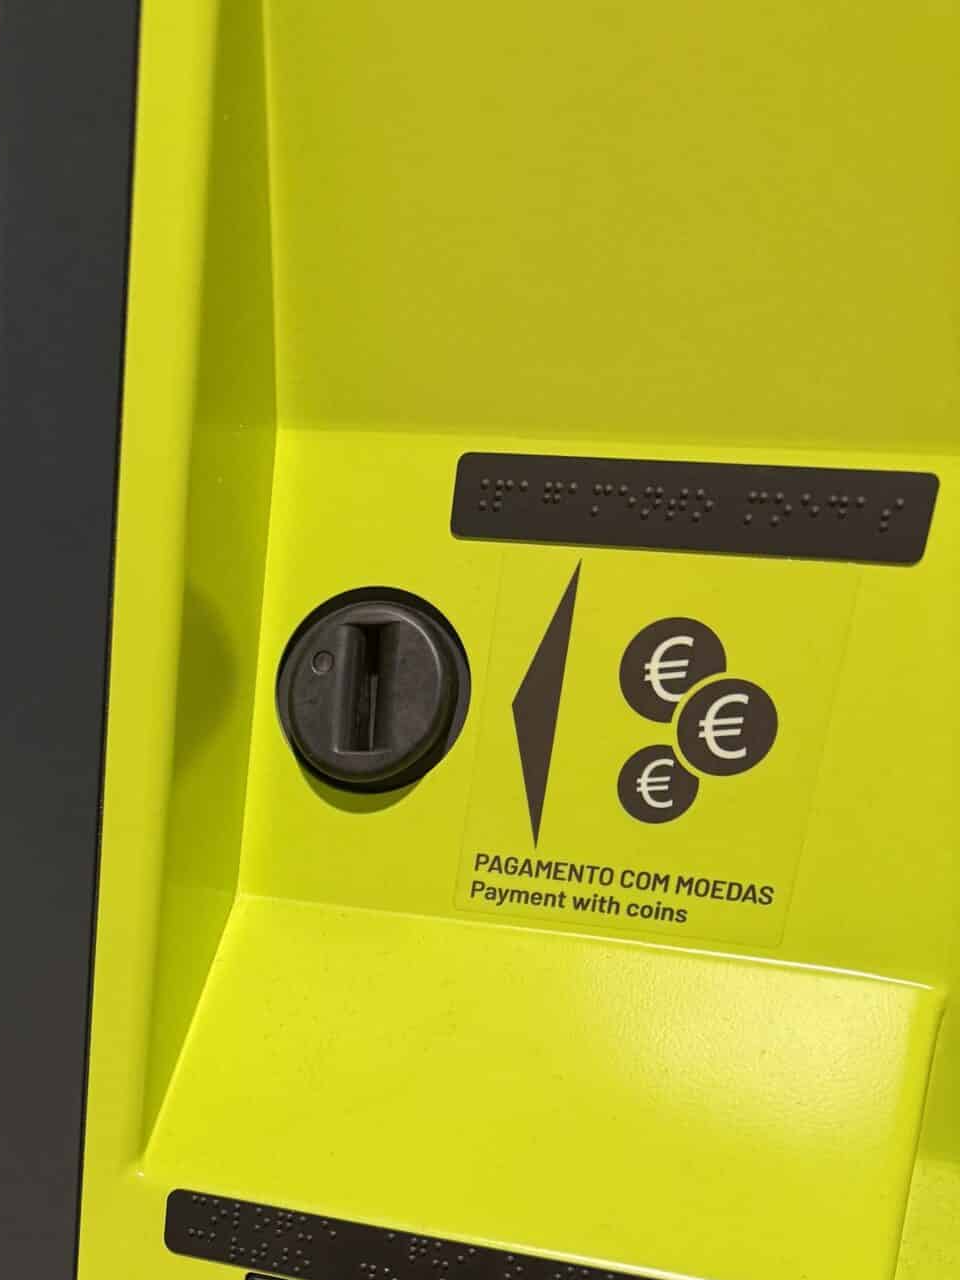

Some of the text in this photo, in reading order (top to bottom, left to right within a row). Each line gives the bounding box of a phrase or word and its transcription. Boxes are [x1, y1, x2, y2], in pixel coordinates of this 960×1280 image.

[470, 880, 688, 924] Payment with coins
[474, 852, 775, 907] PAGAMENTO COM MOEDAS
